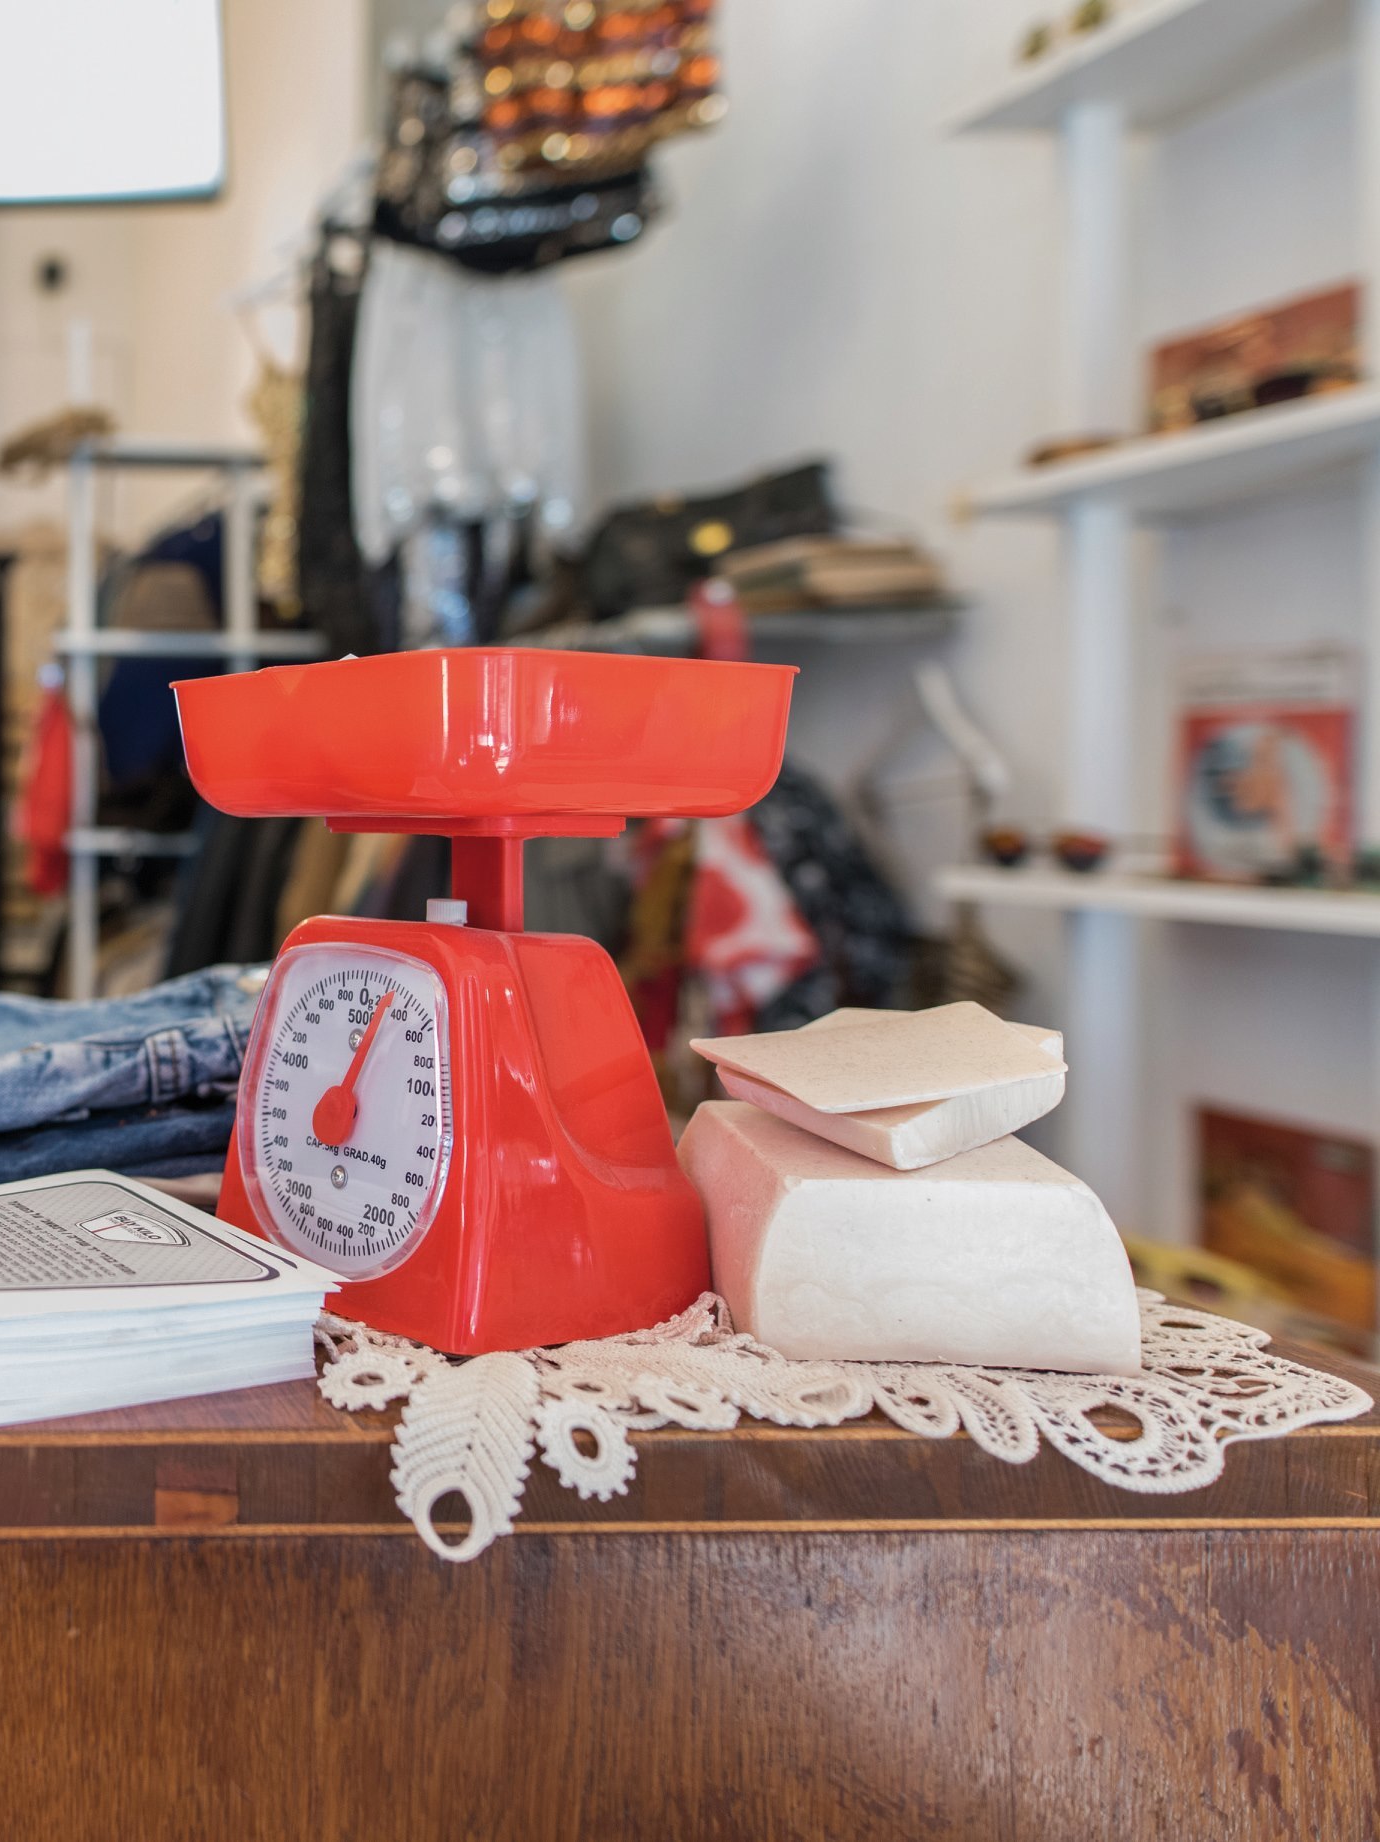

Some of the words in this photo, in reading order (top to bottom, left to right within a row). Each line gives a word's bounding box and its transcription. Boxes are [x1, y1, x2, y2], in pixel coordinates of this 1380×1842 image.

[337, 989, 354, 1002] 800
[318, 998, 334, 1011] 600
[305, 1012, 320, 1025] 400
[390, 1008, 408, 1022] 400
[292, 1031, 307, 1044] 200
[405, 1030, 423, 1044] 600
[282, 1051, 308, 1070] 4000
[275, 1079, 290, 1092] 800
[407, 1078, 434, 1096] 100
[272, 1107, 286, 1120] 600
[421, 1114, 438, 1128] 20
[273, 1135, 288, 1148] 400
[277, 1158, 293, 1172] 200
[343, 1146, 387, 1170] GRAD.40g
[405, 1172, 424, 1187] 600
[285, 1179, 312, 1200] 3000
[391, 1192, 410, 1208] 800
[299, 1202, 316, 1217] 800
[363, 1204, 396, 1227] 2000
[114, 1216, 140, 1226] BUY
[133, 1227, 162, 1240] KILO
[316, 1217, 333, 1232] 600
[336, 1224, 354, 1239] 400
[357, 1222, 376, 1238] 200
